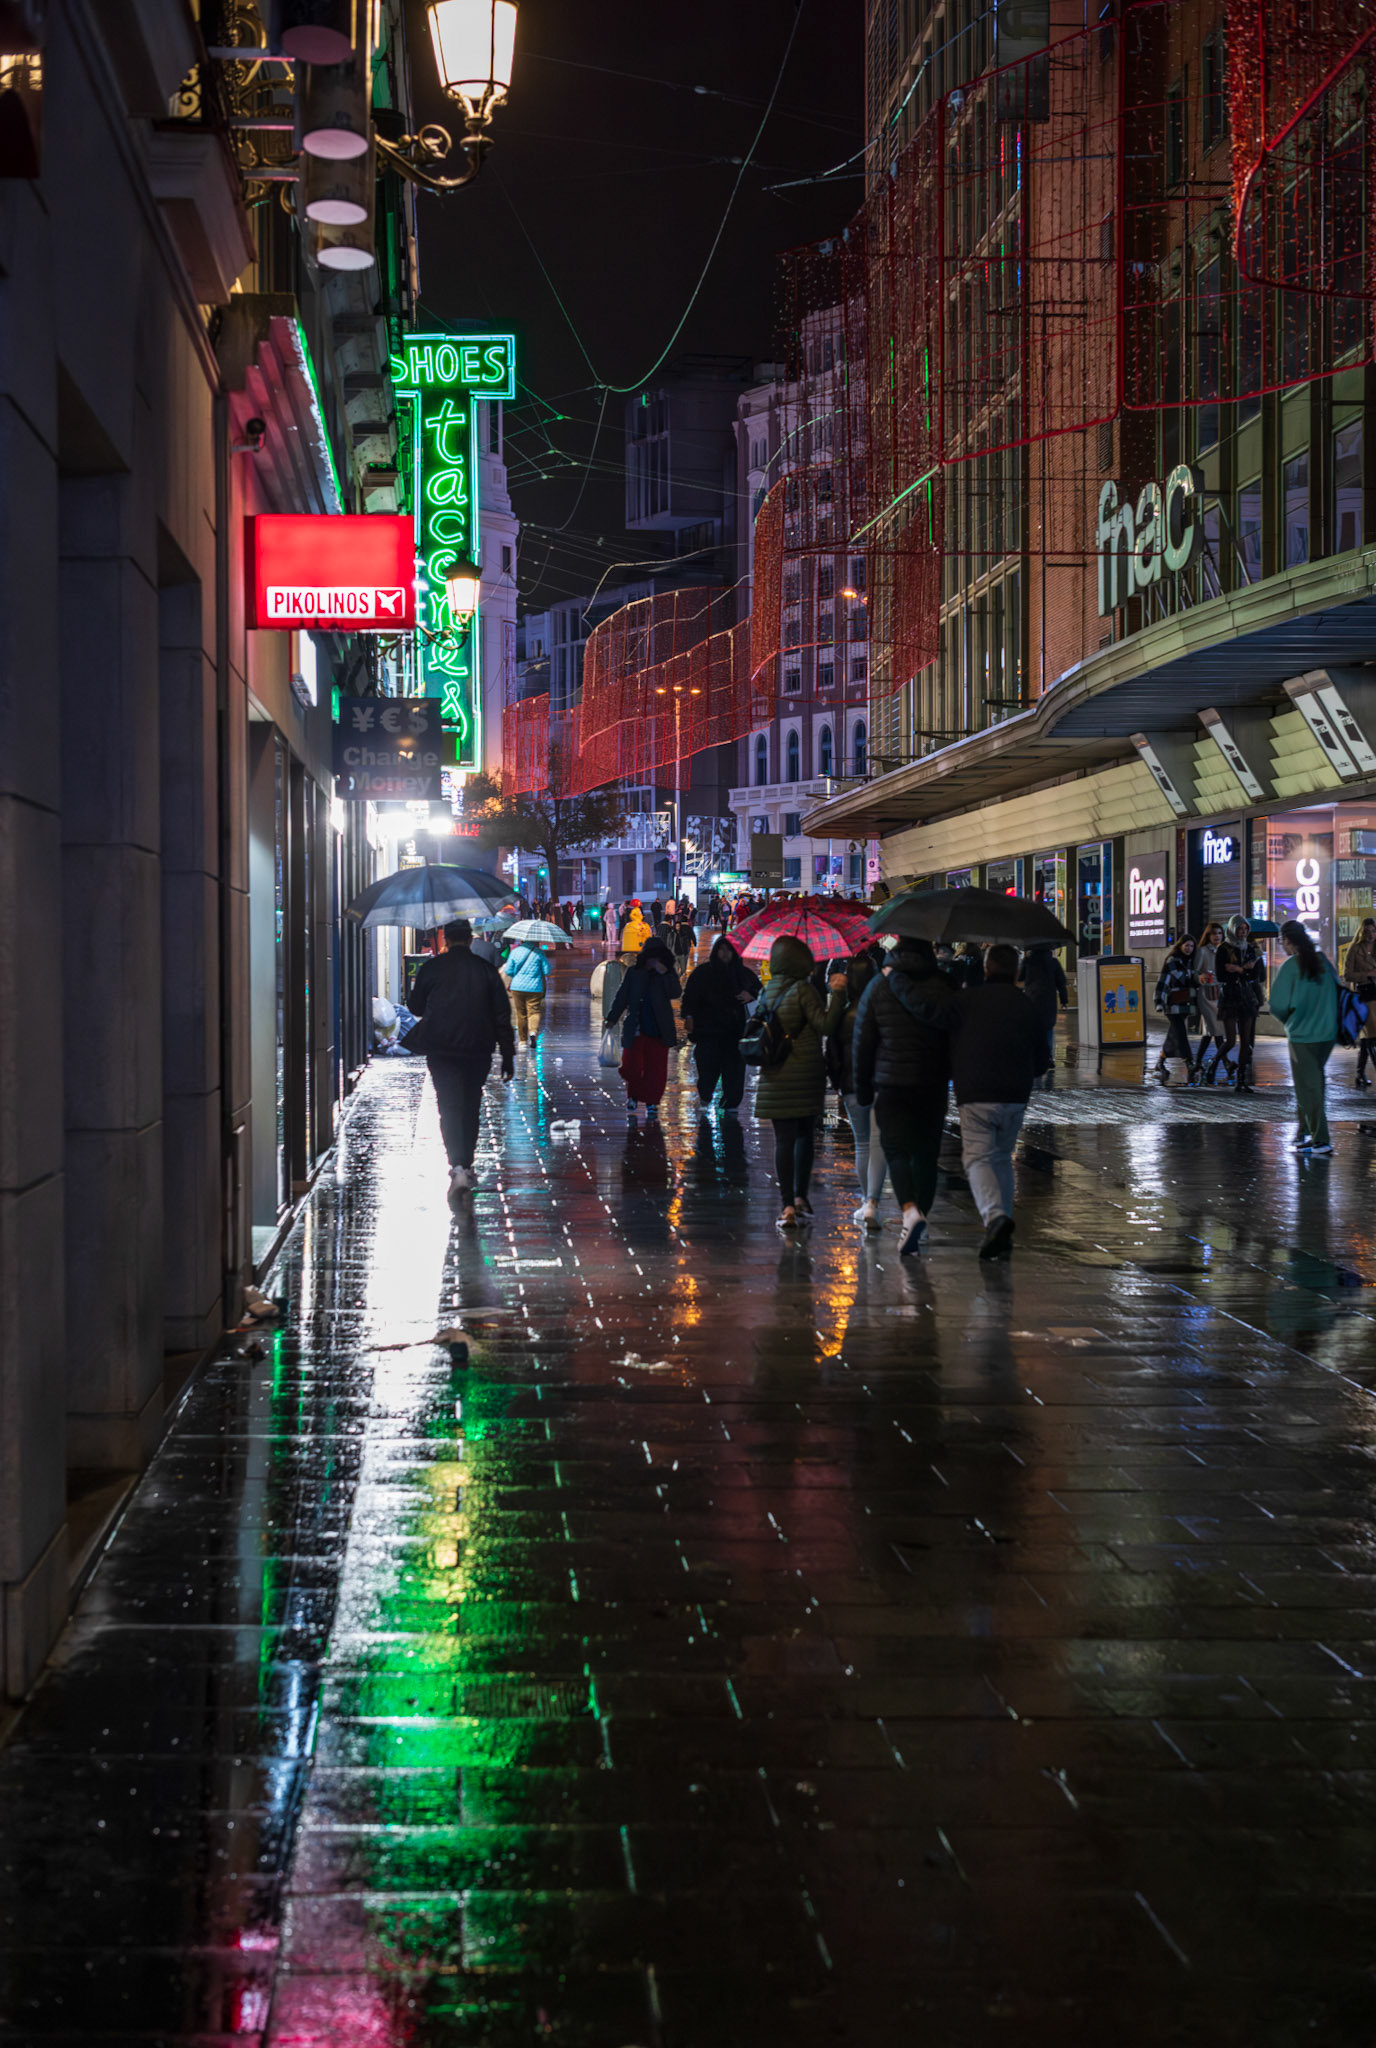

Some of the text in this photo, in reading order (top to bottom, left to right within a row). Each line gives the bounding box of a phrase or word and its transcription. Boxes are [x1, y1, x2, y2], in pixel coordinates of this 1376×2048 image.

[390, 343, 506, 384] SHOES
[1096, 463, 1200, 617] fnac
[274, 591, 370, 614] PIKOLINOS
[343, 746, 439, 771] Change
[353, 771, 433, 796] Money
[1203, 830, 1233, 865] fnac
[1129, 867, 1165, 915] fnac
